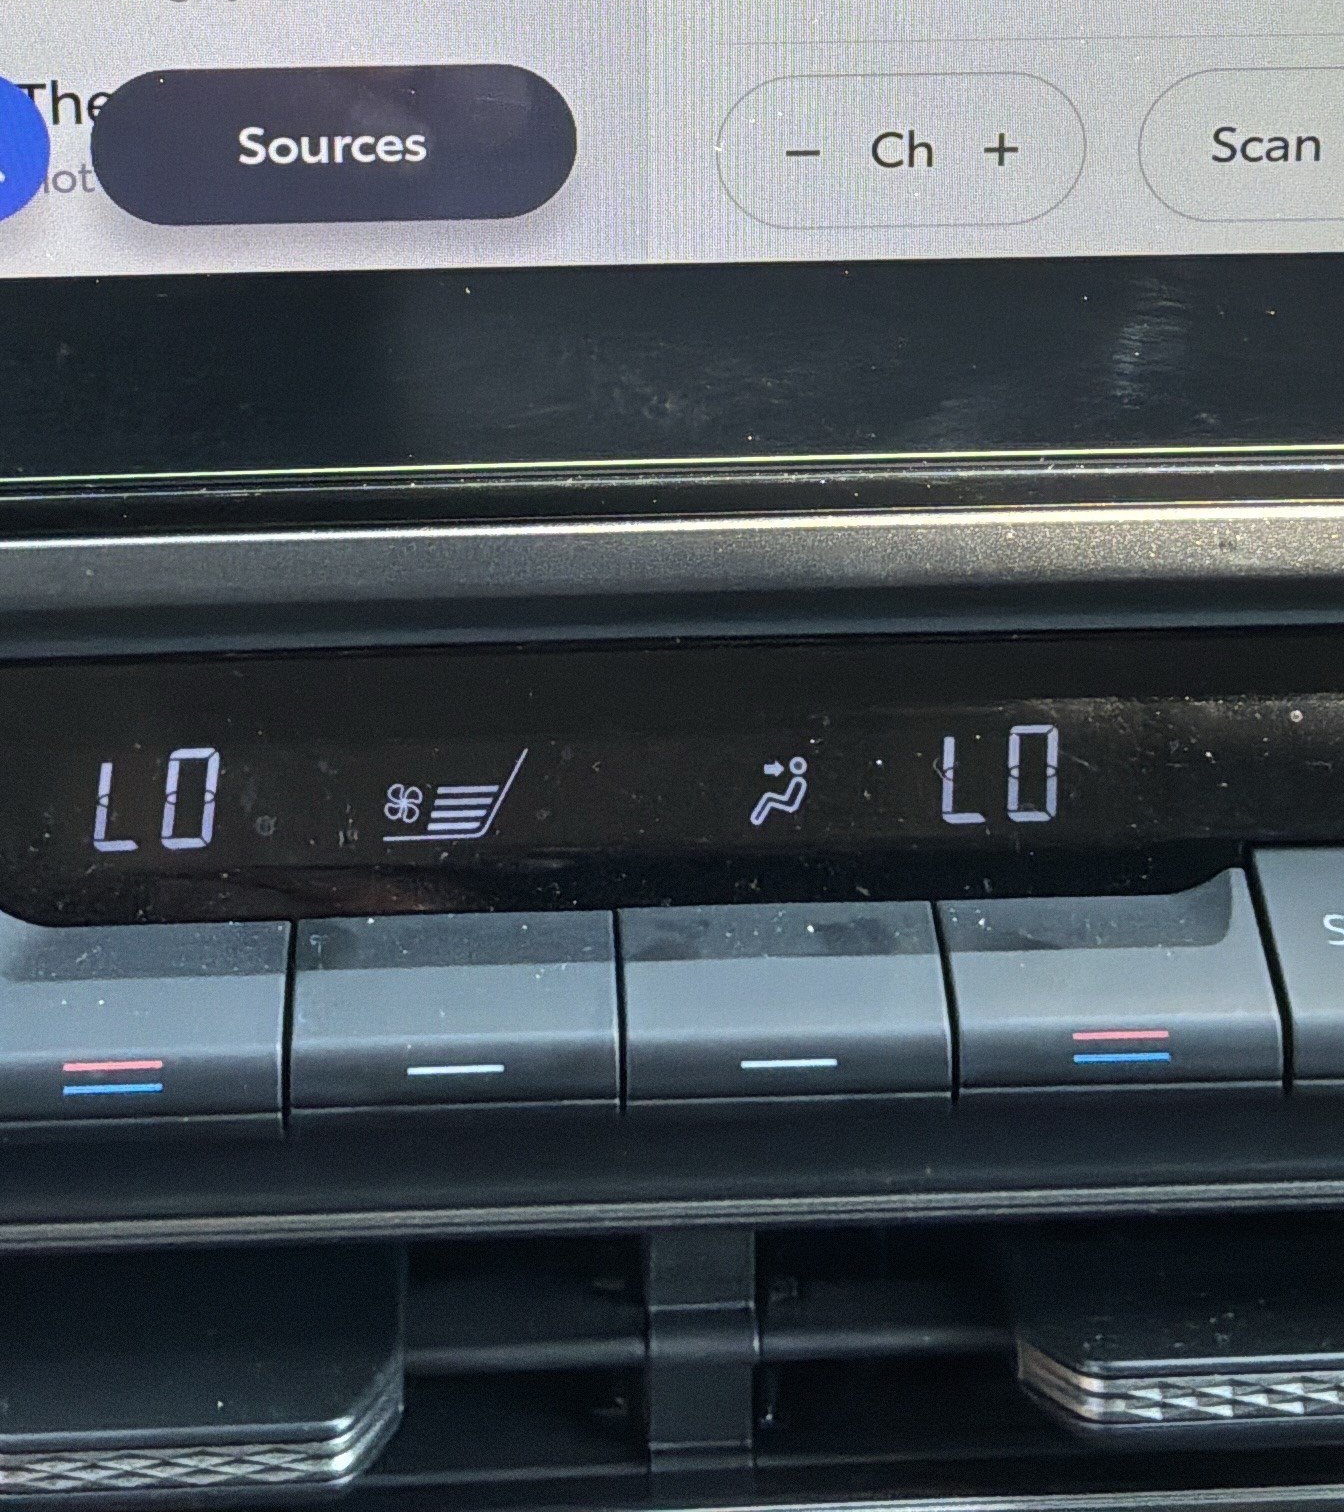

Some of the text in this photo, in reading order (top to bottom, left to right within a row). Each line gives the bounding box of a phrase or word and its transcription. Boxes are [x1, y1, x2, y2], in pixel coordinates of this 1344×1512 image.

[238, 126, 428, 166] Sources
[870, 129, 935, 170] Ch
[1211, 125, 1322, 164] Scan
